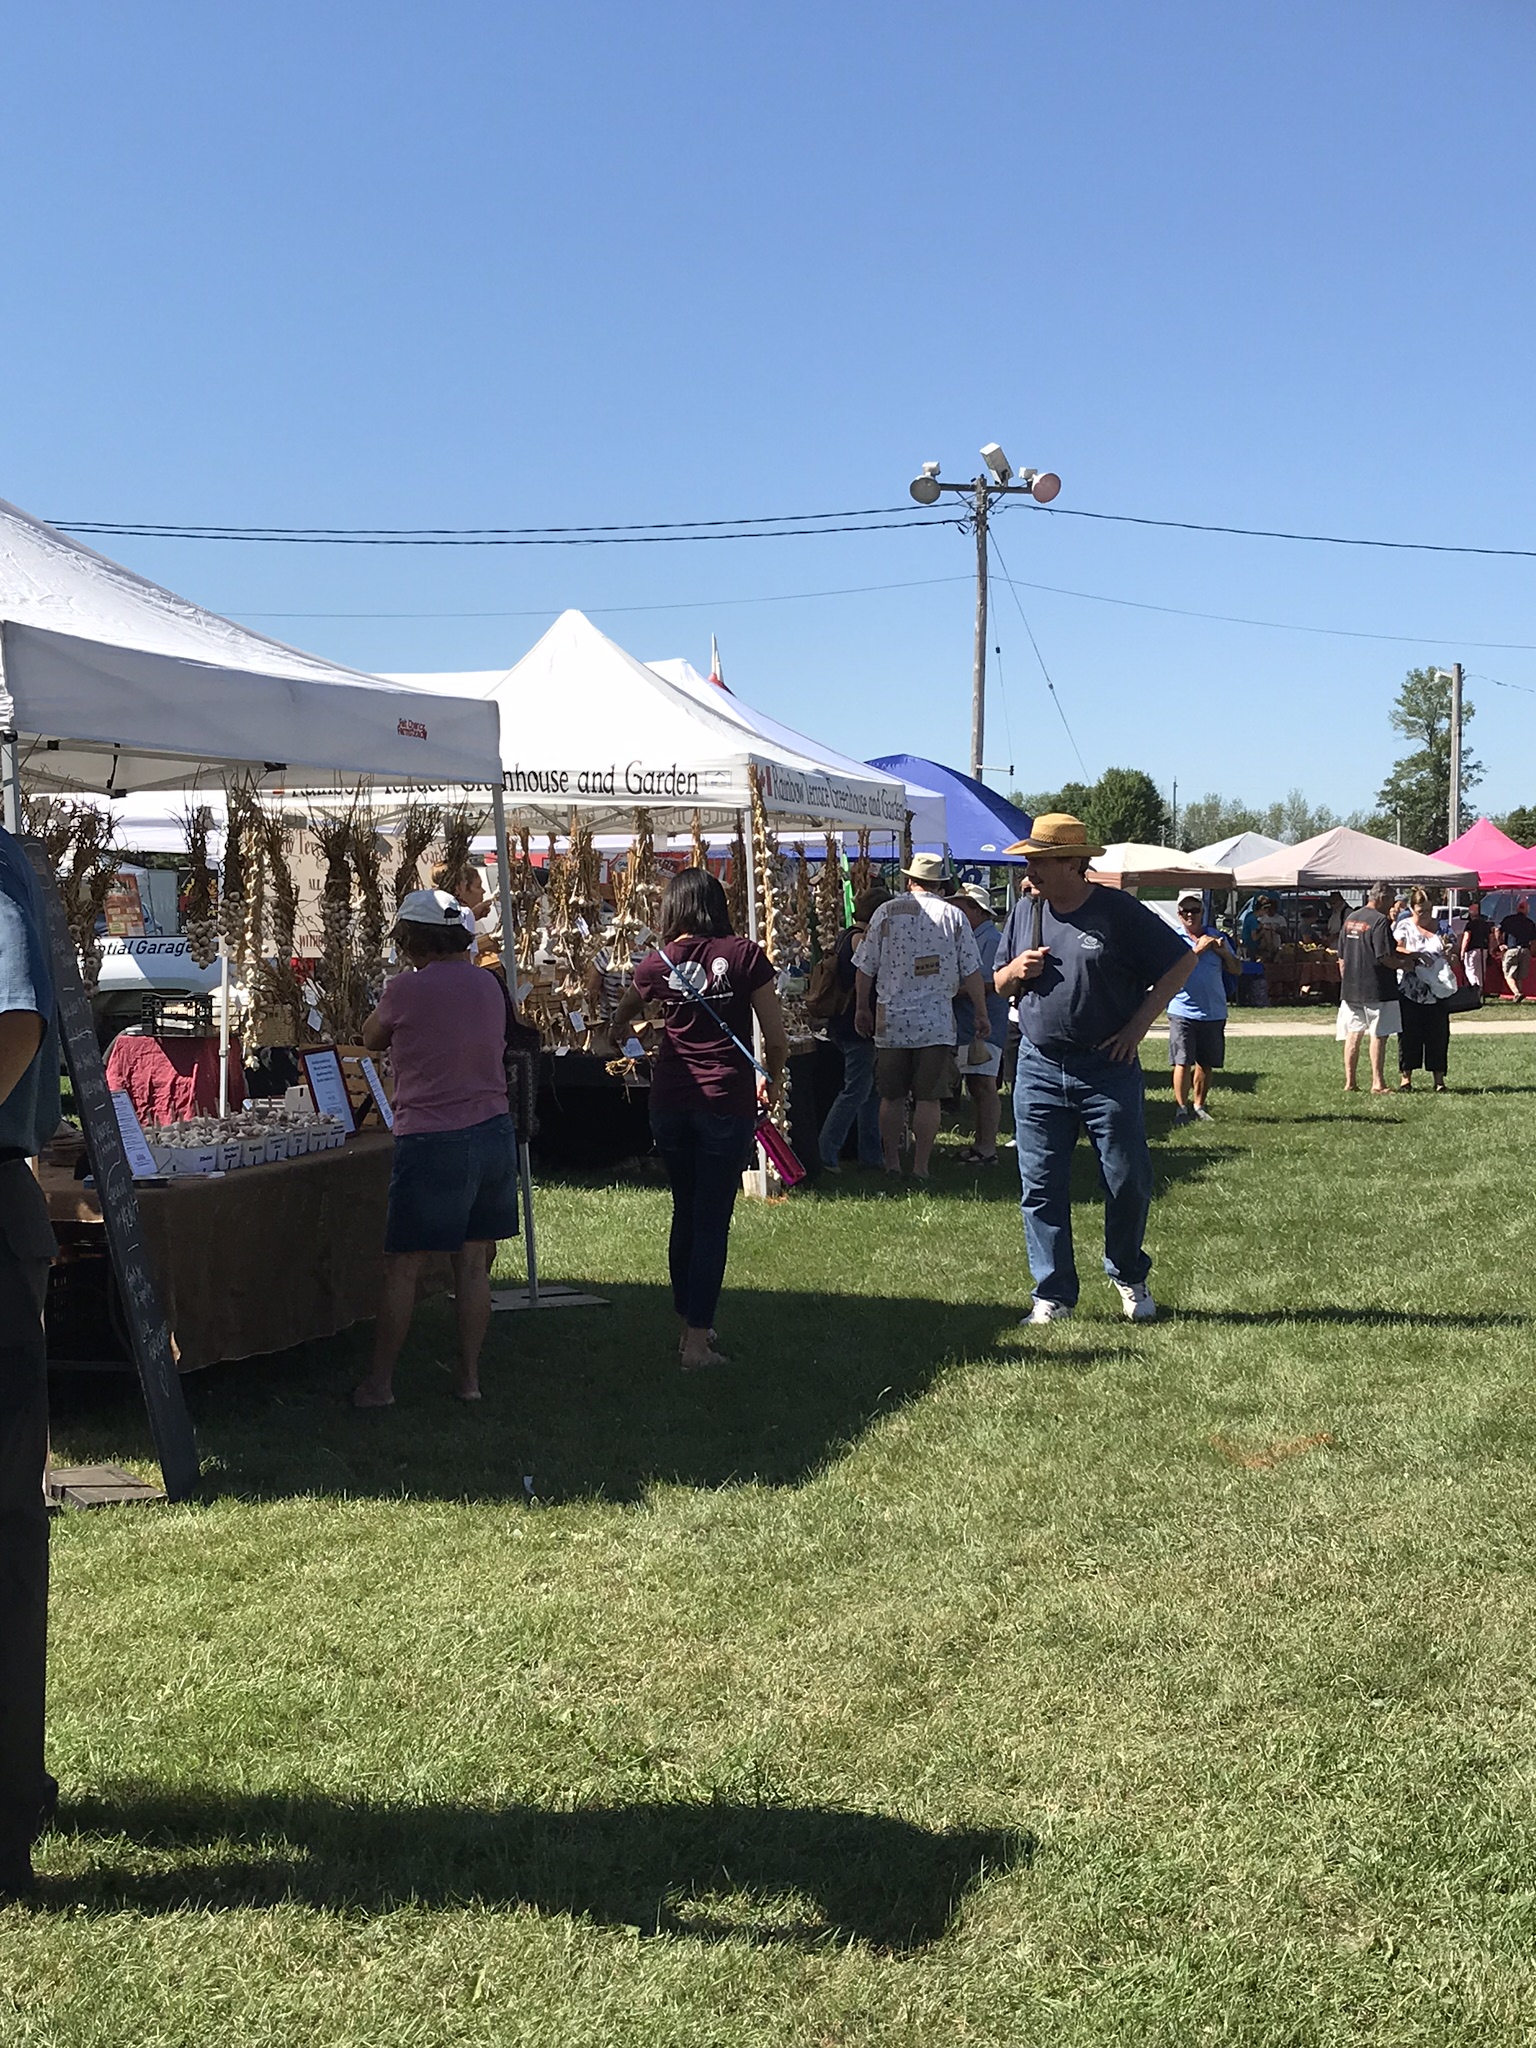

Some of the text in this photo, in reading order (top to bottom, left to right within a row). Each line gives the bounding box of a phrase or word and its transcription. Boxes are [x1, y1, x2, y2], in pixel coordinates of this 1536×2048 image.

[578, 764, 615, 795] and
[625, 760, 699, 797] Garden
[771, 764, 803, 803] Rainbow
[799, 772, 830, 808] Terrace
[826, 777, 868, 815] Greenhouse
[867, 790, 881, 817] and
[880, 788, 905, 821] Garden
[136, 940, 193, 957] Garage
